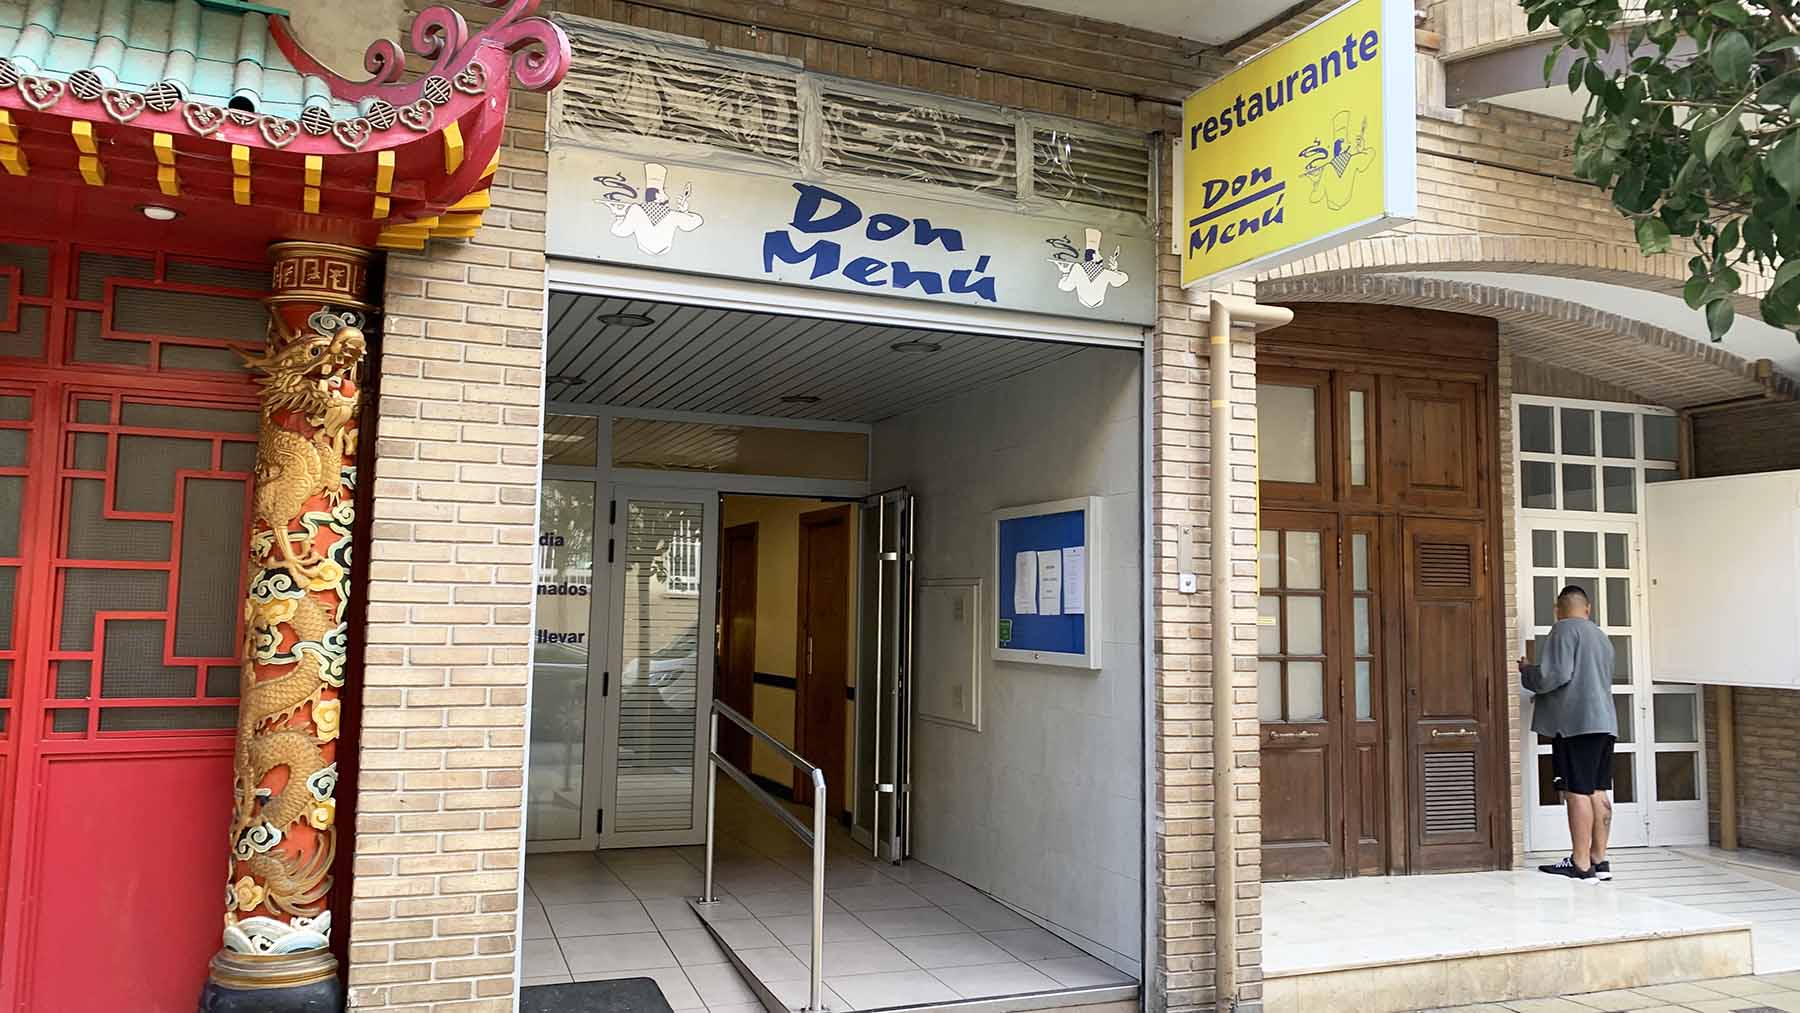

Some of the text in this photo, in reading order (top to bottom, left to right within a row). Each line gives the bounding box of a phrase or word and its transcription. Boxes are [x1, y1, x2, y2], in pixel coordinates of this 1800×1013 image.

[1190, 29, 1378, 150] restaurante
[789, 182, 965, 252] Don
[1202, 166, 1272, 209] Don
[1189, 193, 1285, 260] Menú
[763, 230, 997, 302] Menú
[537, 629, 585, 644] llevar
